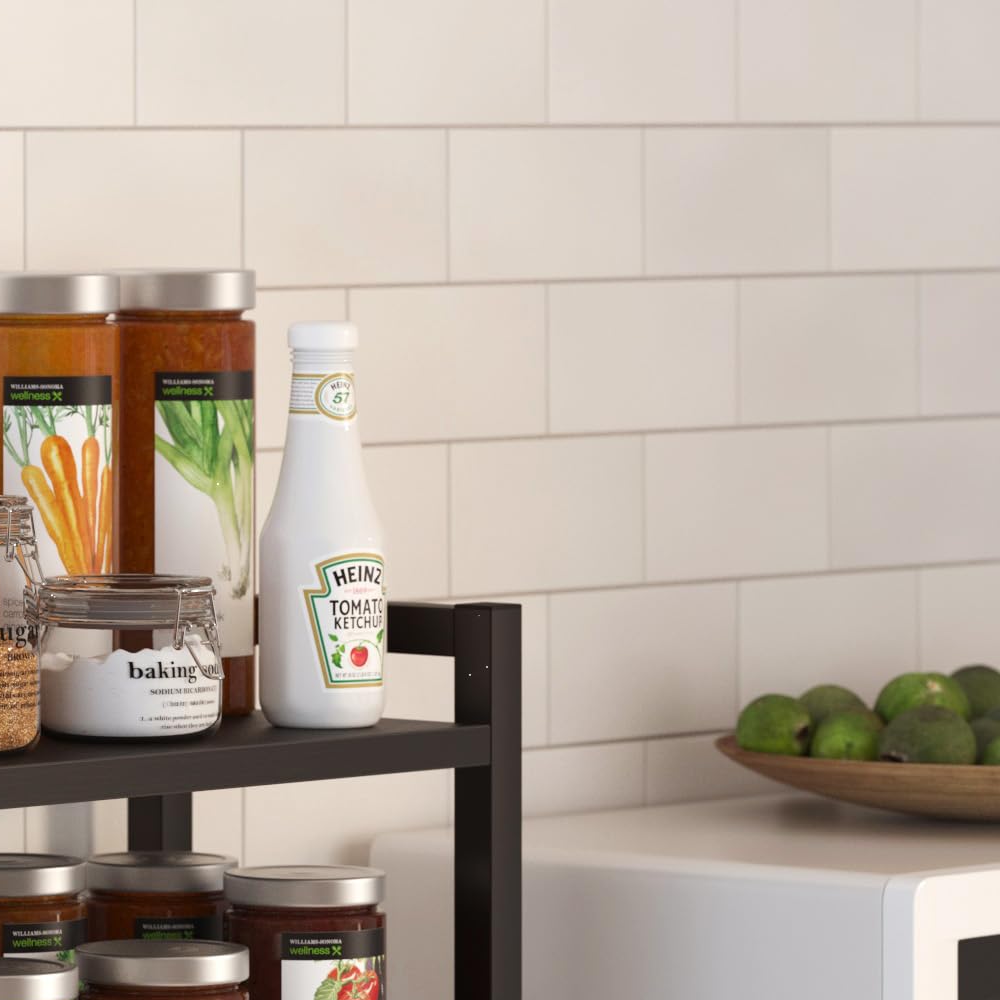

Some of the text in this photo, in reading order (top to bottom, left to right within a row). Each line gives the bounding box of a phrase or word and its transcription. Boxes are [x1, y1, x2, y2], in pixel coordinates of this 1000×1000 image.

[10, 391, 51, 401] wellness
[332, 392, 350, 404] 57
[333, 565, 382, 587] HEINZ
[127, 661, 199, 684] baking
[12, 937, 52, 948] wellness
[290, 946, 330, 956] wellness
